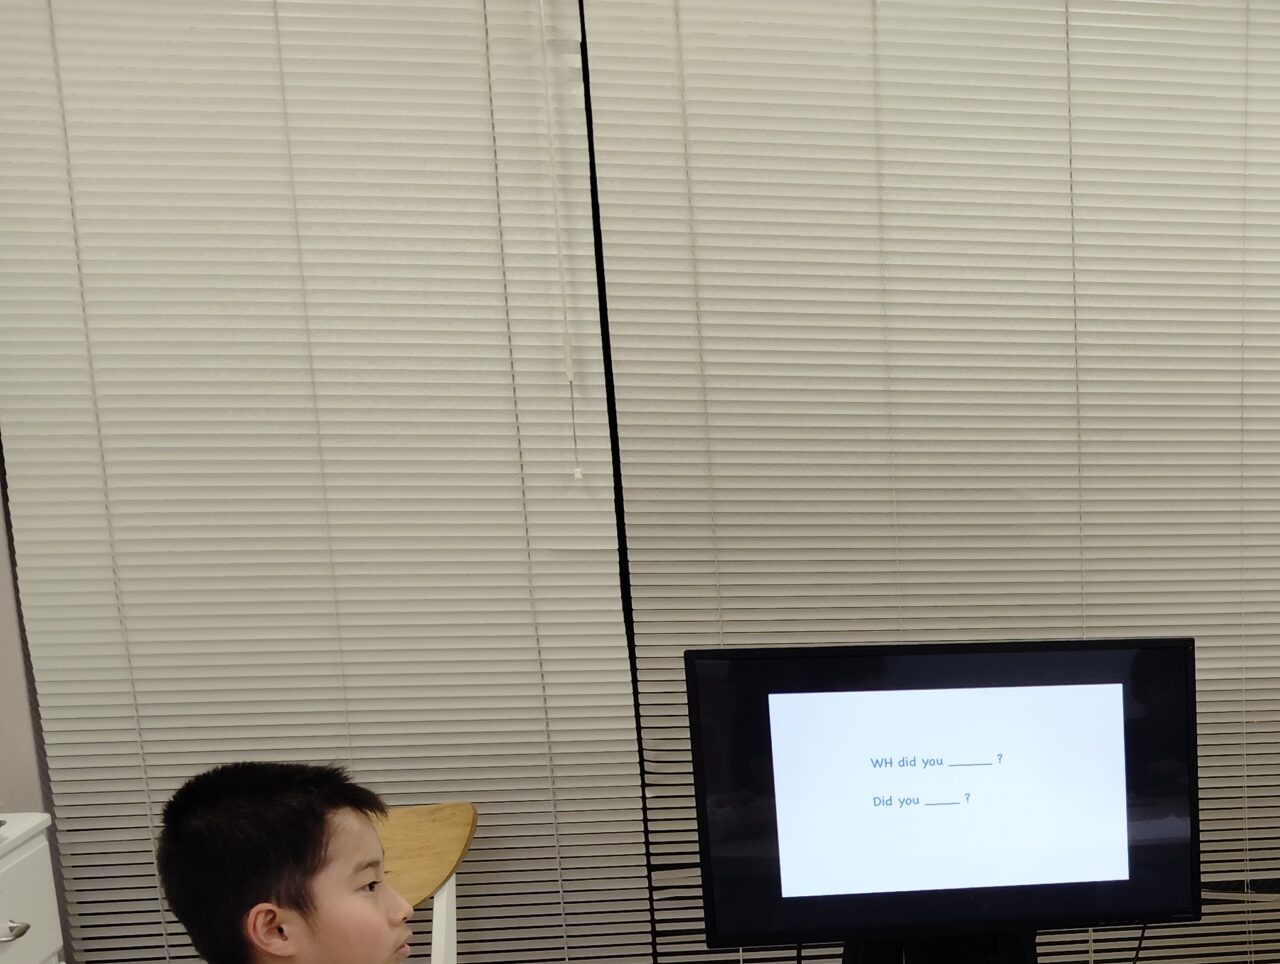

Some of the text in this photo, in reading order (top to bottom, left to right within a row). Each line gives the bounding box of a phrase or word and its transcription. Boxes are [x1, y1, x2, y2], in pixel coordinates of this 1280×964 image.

[870, 753, 1003, 769] WH did you ?
[873, 792, 971, 809] Did you ?
